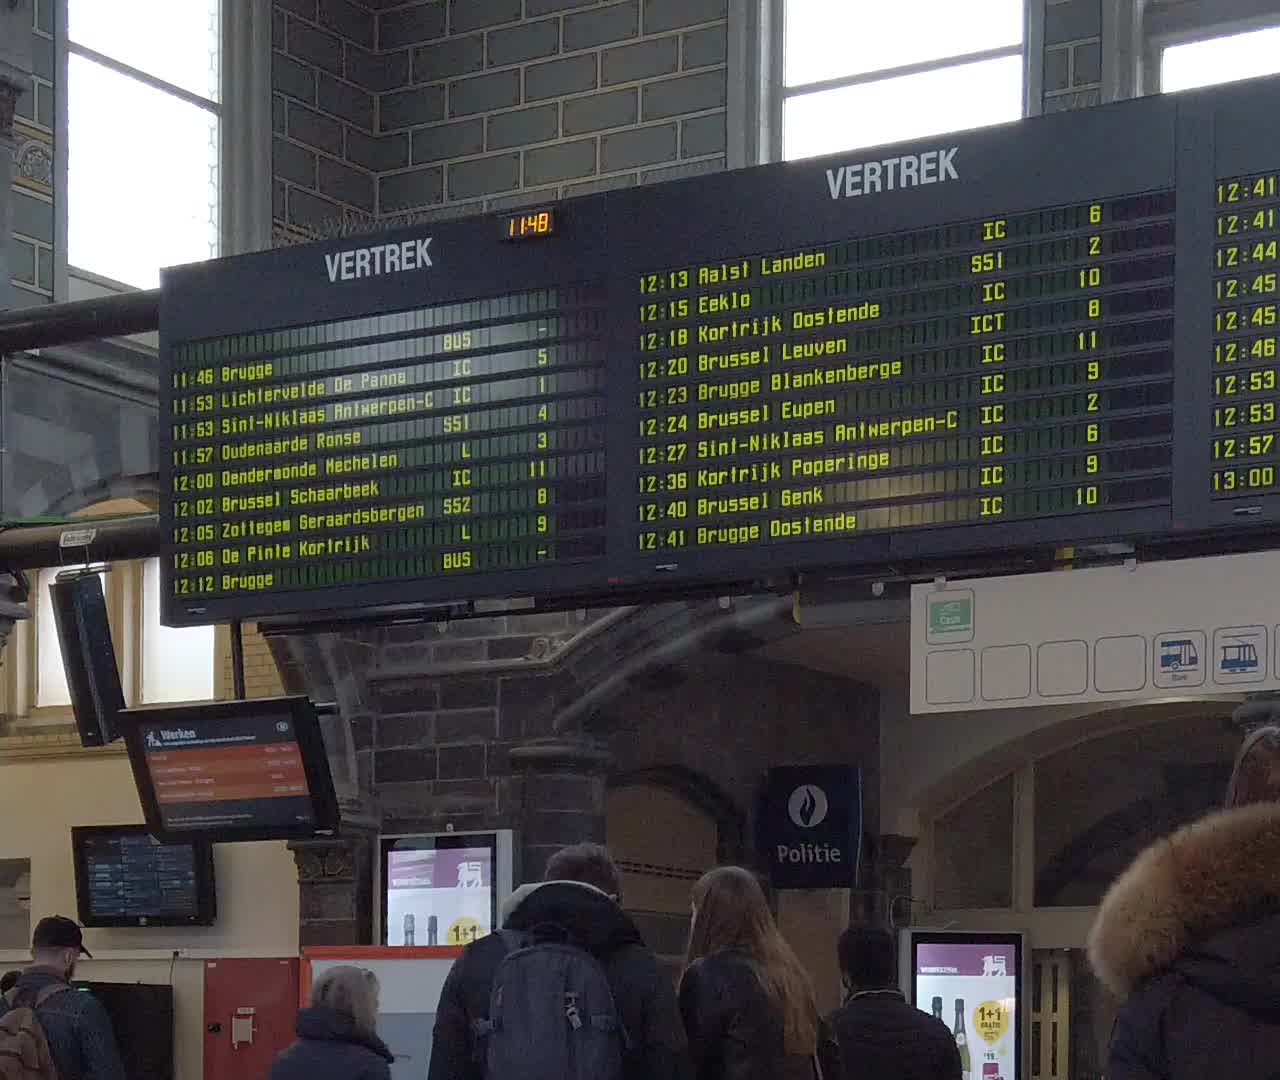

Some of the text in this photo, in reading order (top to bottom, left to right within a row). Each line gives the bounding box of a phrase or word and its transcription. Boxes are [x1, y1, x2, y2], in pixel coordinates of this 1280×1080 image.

[827, 147, 959, 199] VERTREK
[1217, 174, 1278, 204] 12:41
[508, 213, 550, 237] 11:48
[1216, 207, 1277, 236] 12:41
[325, 238, 433, 282] VERTREK
[640, 204, 1101, 294] 12:13 Aalst Landen IC 6
[1216, 239, 1277, 268] 12:44
[640, 298, 687, 323] 12:15
[698, 289, 749, 314] Eeklo
[1089, 236, 1101, 257] 2
[1215, 272, 1276, 301] 12:45
[639, 267, 1101, 351] 12:18 Kortrijk Oostende IC 10
[1214, 304, 1276, 333] 12:45
[173, 332, 471, 389] 11:46 Brugge BUS
[639, 299, 1099, 380] 12:20 Brussel Leuven ICT 8
[1214, 337, 1275, 365] 12:46
[173, 393, 212, 414] 11:53
[222, 379, 324, 408] Lichtervelde
[334, 375, 351, 394] De
[361, 368, 405, 390] Panne
[452, 359, 471, 378] IC
[639, 330, 1096, 408] 12:23 Brugge Blankenberge IC 11
[1213, 369, 1274, 397] 12:53
[222, 405, 324, 434] Sint-Niklaas
[334, 391, 433, 420] Antwerpen-C
[452, 387, 471, 406] IC
[639, 361, 1098, 437] 12:24 Brussel Eupen IC 9
[1213, 402, 1274, 429] 12:53
[173, 445, 212, 466] 11:57
[222, 434, 306, 460] Oudenaarde
[317, 427, 360, 449] Ronse
[639, 393, 1098, 465] 12:27 Sint-Niklaas Antwerpen-C IC 2
[1212, 434, 1273, 461] 12:57
[173, 471, 212, 492] 12:00
[222, 459, 315, 486] Dendermonde
[325, 450, 396, 475] Mechelen
[461, 441, 470, 459] L
[638, 424, 1097, 494] 12:36 Kortrijk Poperinge IC 6
[1212, 467, 1273, 493] 13:00
[173, 497, 212, 517] 12:02
[222, 490, 280, 512] Brussel
[290, 479, 378, 505] Schaarbeek
[452, 469, 470, 488] IC
[638, 455, 1097, 522] 12:40 Brussel Genk IC 9
[173, 523, 212, 543] 12:05
[222, 515, 289, 538] Zottegem
[299, 501, 423, 530] Geraardsbergen
[638, 486, 1097, 551] 12:41 Brugge Oostende IC 10
[173, 549, 212, 569] 12:06
[222, 547, 237, 564] De
[247, 541, 289, 562] Pinte
[299, 534, 368, 557] Kortrijk
[461, 523, 470, 541] L
[173, 551, 470, 594] 12:12 Brugge BUS
[778, 841, 841, 866] Politie
[453, 925, 477, 942] 1+1
[978, 1006, 1001, 1021] 1+1
